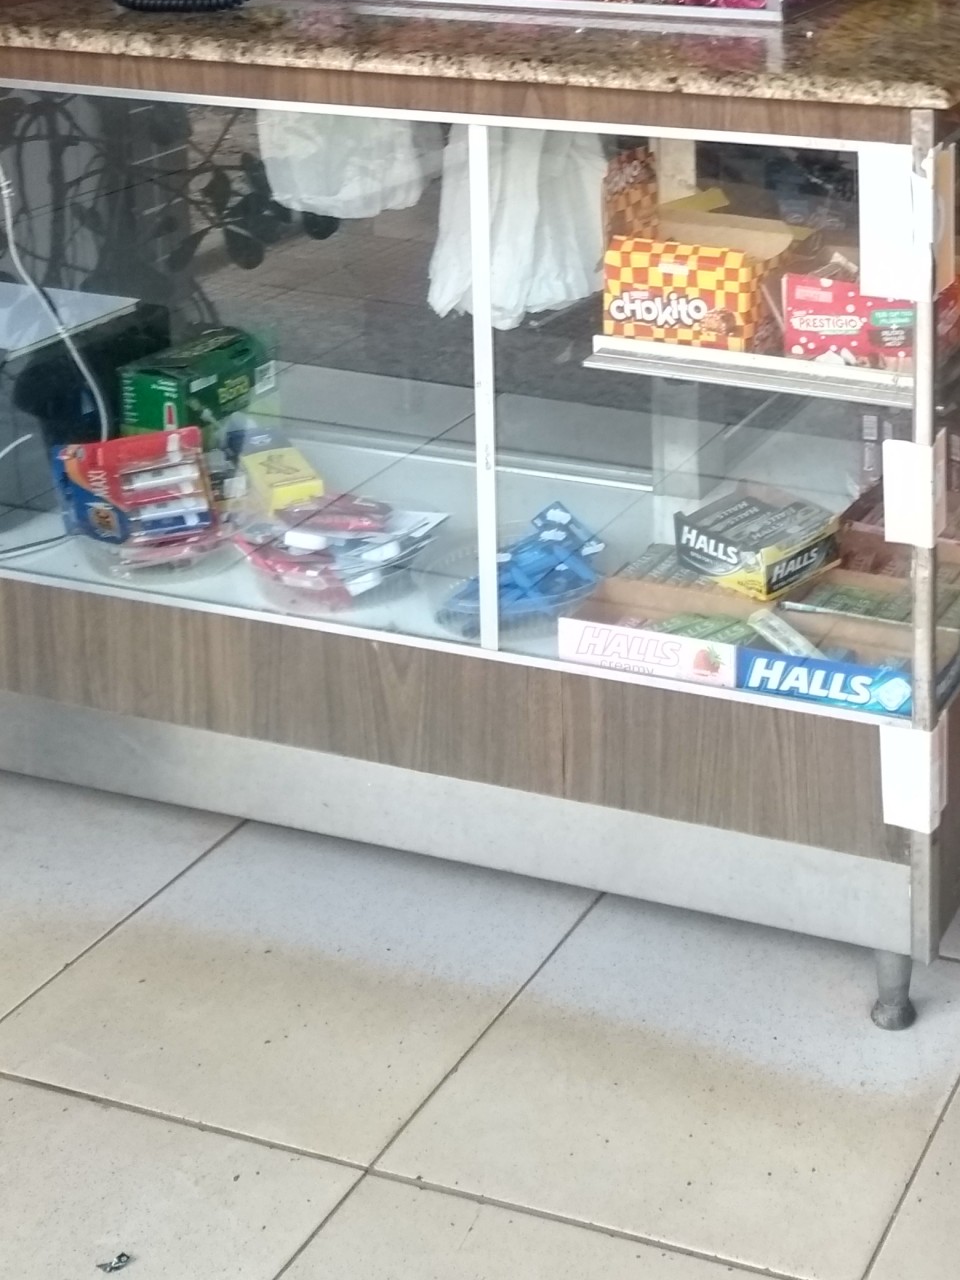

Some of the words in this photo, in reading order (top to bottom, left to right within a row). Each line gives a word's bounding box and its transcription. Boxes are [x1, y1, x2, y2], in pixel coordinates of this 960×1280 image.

[681, 525, 738, 564] HALLS
[771, 547, 819, 584] HALLS
[575, 625, 682, 668] HALLS
[748, 657, 873, 705] HALLS
